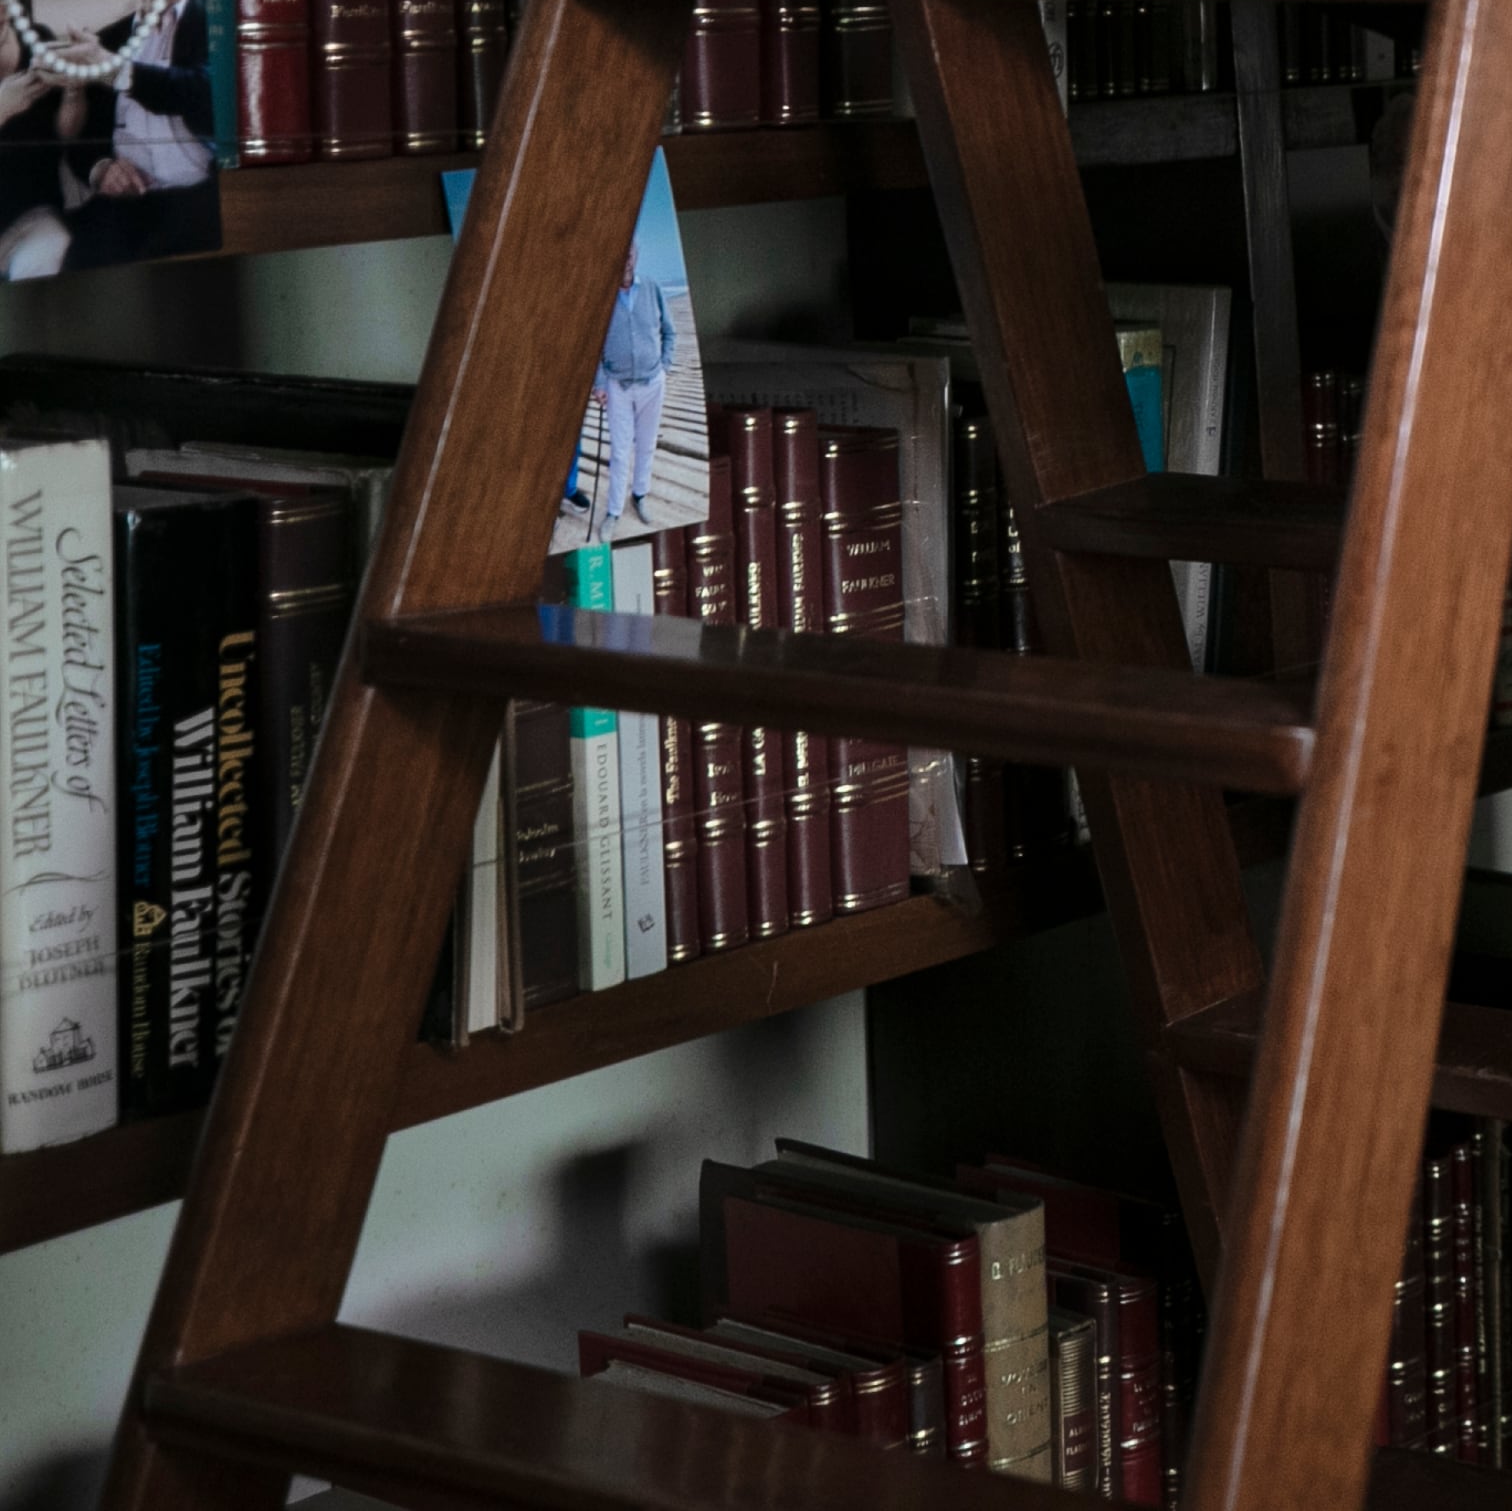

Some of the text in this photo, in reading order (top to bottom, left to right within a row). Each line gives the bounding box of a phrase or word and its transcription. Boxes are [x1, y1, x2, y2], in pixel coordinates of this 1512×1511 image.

[842, 574, 896, 593] FAULKNER
[846, 539, 892, 557] WILLIAM
[7, 489, 52, 860] WILLIAM FAULKNER
[50, 528, 109, 815] Selected Letters of
[132, 642, 162, 887] Edited by Joseph Blotner
[216, 630, 256, 867] Uncollected
[666, 774, 680, 805] The
[29, 904, 100, 933] Edited by
[168, 706, 215, 1070] William Faulkner
[600, 834, 613, 921] GLISSANT
[29, 937, 101, 969] JOSEPH
[214, 869, 252, 1012] Stories
[131, 941, 151, 1078] Random House
[7, 1068, 114, 1106] RANDOM HOUSE
